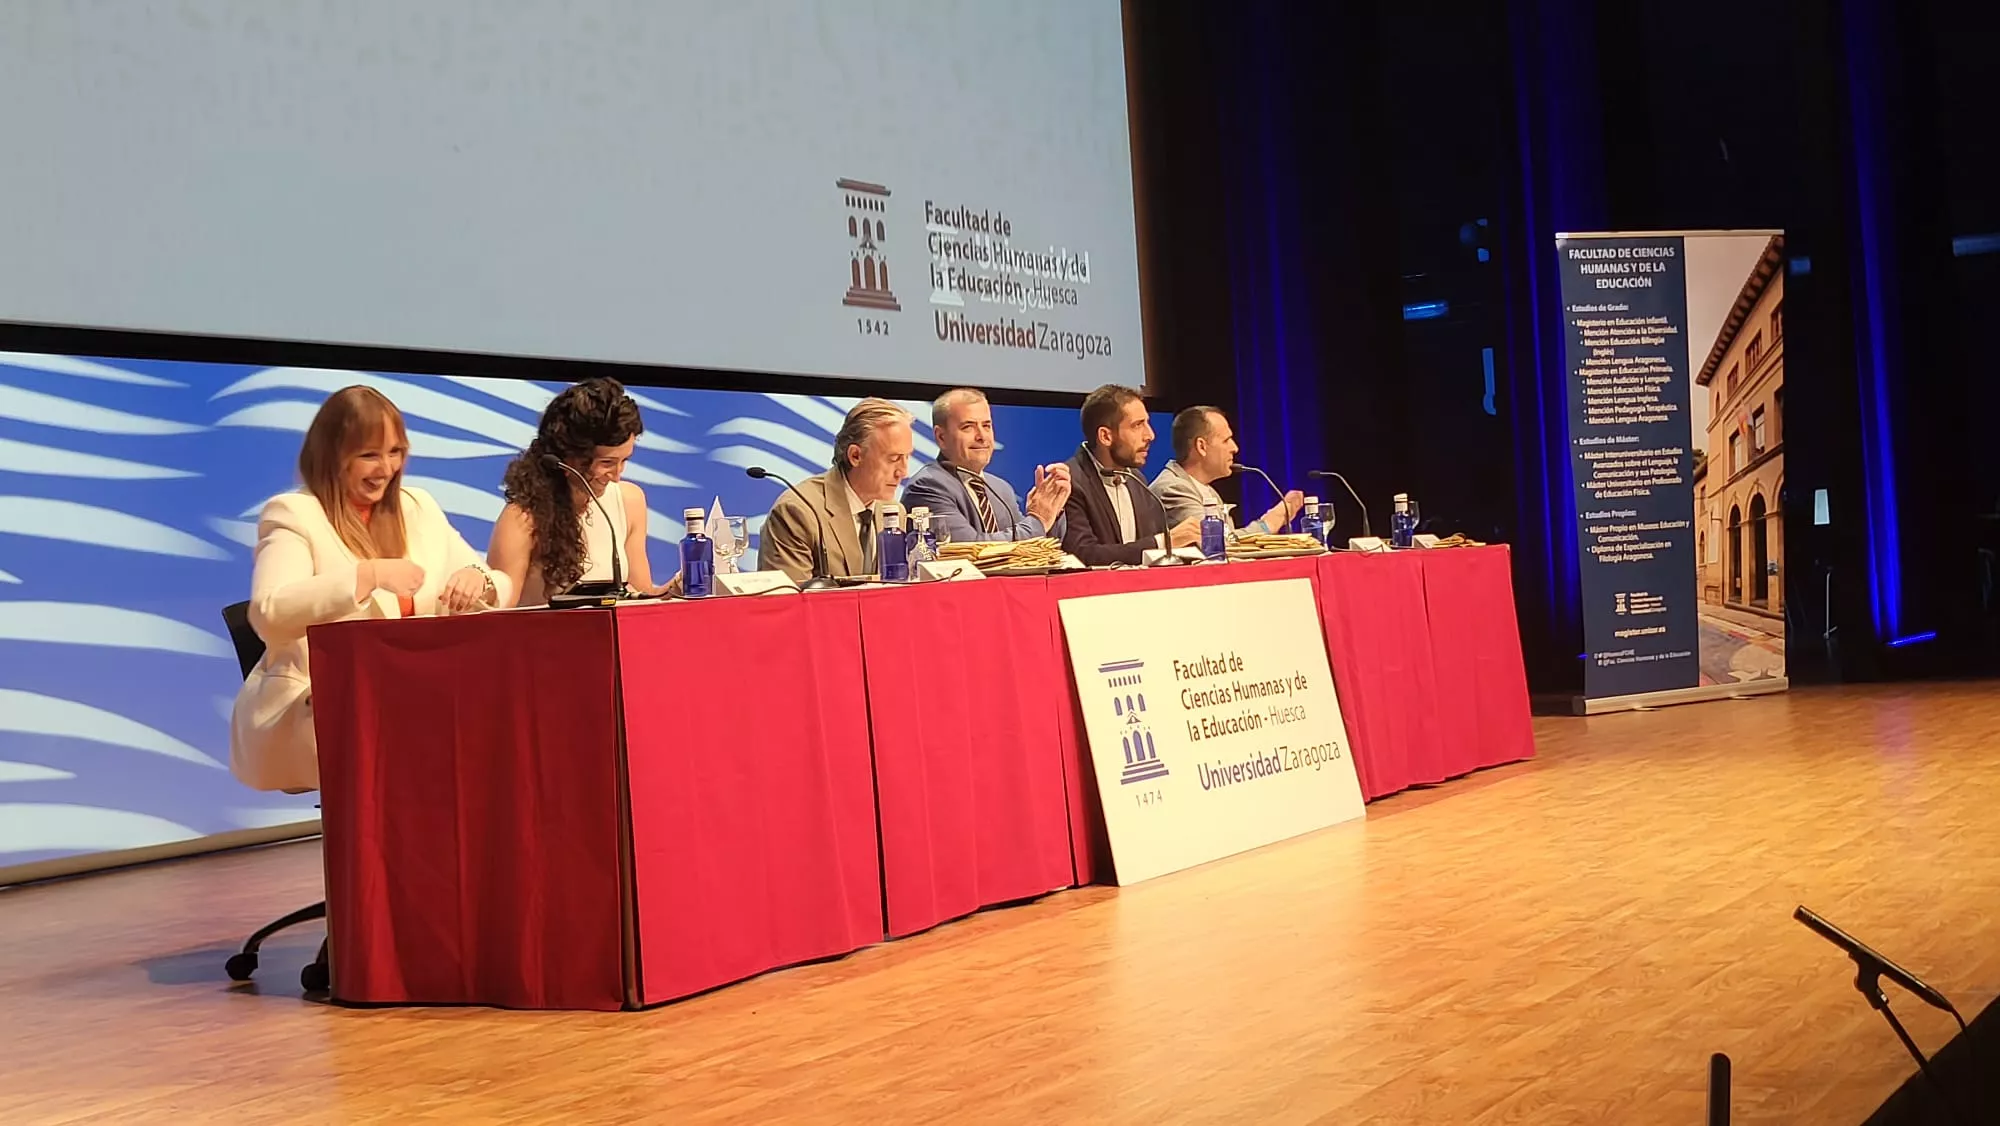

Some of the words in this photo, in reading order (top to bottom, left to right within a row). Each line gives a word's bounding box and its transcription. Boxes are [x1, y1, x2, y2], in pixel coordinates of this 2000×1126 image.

[924, 200, 990, 234] Facultad
[993, 210, 1012, 237] de
[927, 231, 990, 263] Ciencias
[1568, 248, 1617, 260] FACULTAD
[1618, 248, 1632, 259] DE
[1632, 247, 1675, 258] CIENCIAS
[1580, 263, 1629, 274] HUMANAS
[1630, 262, 1638, 273] Y
[1638, 262, 1652, 273] DE
[1653, 261, 1667, 272] LA
[929, 262, 945, 291] la
[948, 265, 1024, 299] Educación
[1032, 279, 1079, 306] Huesca
[1596, 276, 1652, 289] EDUCACIÓN
[1571, 304, 1598, 312] Estudios
[1599, 304, 1607, 312] de
[857, 319, 889, 336] 1542
[1576, 318, 1607, 328] Magisterio
[1616, 317, 1646, 326] Educación
[934, 310, 1036, 350] Universidad
[1037, 322, 1113, 360] Zaragoza
[1583, 329, 1609, 337] Mención
[1641, 327, 1648, 335] la
[1584, 338, 1610, 347] Mención
[1610, 337, 1641, 346] Educación
[1585, 357, 1611, 366] Mención
[1611, 357, 1634, 367] Lengua
[1578, 367, 1610, 377] Magisterio
[1618, 366, 1649, 375] Educación
[1586, 377, 1612, 386] Mención
[1587, 387, 1613, 395] Mención
[1613, 385, 1644, 394] Educación
[1587, 397, 1613, 405] Mención
[1613, 396, 1636, 405] Lengua
[1588, 406, 1614, 415] Mención
[1588, 416, 1615, 425] Mención
[1615, 415, 1638, 424] Lengua
[1579, 437, 1606, 446] Estudios
[1606, 436, 1615, 444] de
[1584, 451, 1604, 460] Máster
[1654, 448, 1662, 456] en
[1641, 458, 1647, 466] el
[1592, 469, 1634, 479] Comunicación
[1640, 468, 1650, 476] sus
[1586, 480, 1606, 489] Máster
[1643, 477, 1652, 486] en
[1594, 490, 1603, 498] de
[1603, 488, 1633, 498] Educación
[1585, 511, 1611, 520] Estudios
[1629, 523, 1637, 531] en
[1615, 543, 1623, 551] de
[1173, 653, 1227, 681] Facultad
[1228, 651, 1244, 672] de
[1181, 684, 1232, 711] Ciencias
[1231, 678, 1285, 702] Humanas
[1284, 678, 1294, 698] y
[1294, 671, 1308, 690] de
[1186, 719, 1202, 742] la
[1200, 708, 1263, 738] Educación
[1267, 702, 1306, 724] Huesca
[1197, 747, 1283, 791] Universidad
[1280, 740, 1341, 772] Zaragoza
[1135, 788, 1163, 808] 1474
